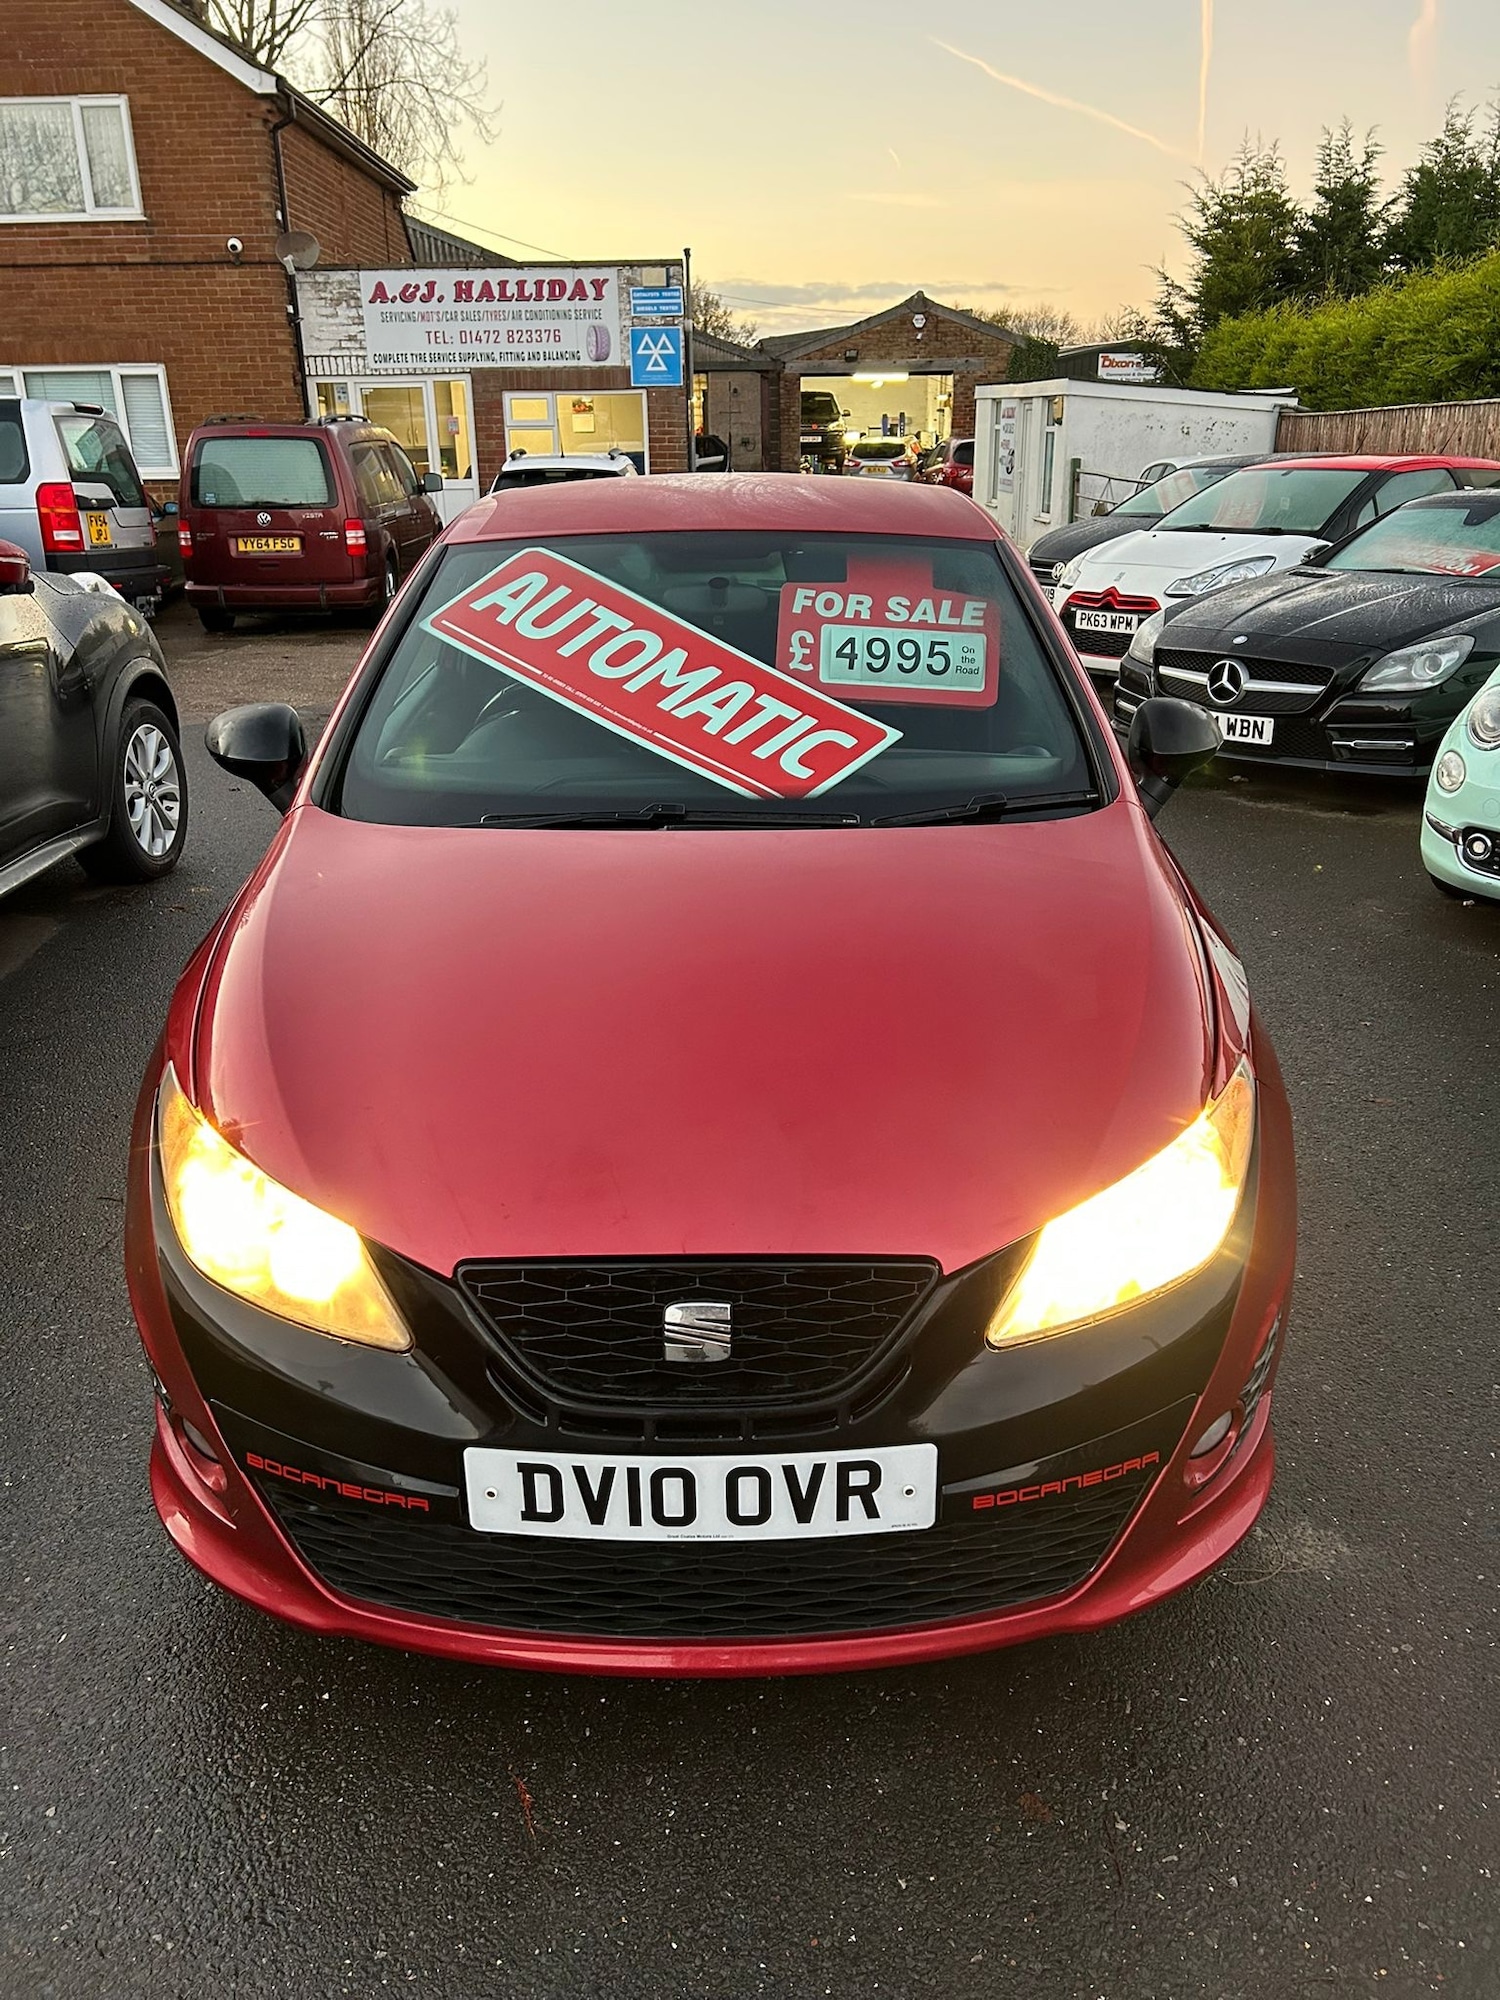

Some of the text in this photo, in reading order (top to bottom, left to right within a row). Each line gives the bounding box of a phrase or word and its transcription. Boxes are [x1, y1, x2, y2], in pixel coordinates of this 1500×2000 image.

[453, 278, 609, 302] HALLIDAY
[524, 308, 573, 320] CONDITIONING
[574, 308, 602, 320] SERVICE
[425, 328, 561, 345] TEL: 01472 823376
[373, 352, 408, 364] COMPLETE
[410, 352, 427, 363] TYRE
[429, 352, 457, 363] SERVICE
[500, 351, 525, 362] FITTING
[527, 351, 541, 361] AND
[543, 350, 581, 361] BALANCING
[88, 514, 108, 527] FY54
[242, 538, 295, 549] YY64 FSG
[791, 587, 987, 626] FOR SALE
[1079, 612, 1133, 631] PK63 WPM
[789, 630, 951, 676] £ 4995
[961, 644, 975, 654] On
[955, 664, 980, 676] Road
[960, 656, 976, 665] the
[469, 571, 858, 779] AUTOMATIC
[1226, 716, 1265, 740] WBN
[246, 1452, 429, 1512] BOCANEGRA
[973, 1450, 1160, 1509] BOCANEGRA
[516, 1459, 882, 1528] DV10 OVR
